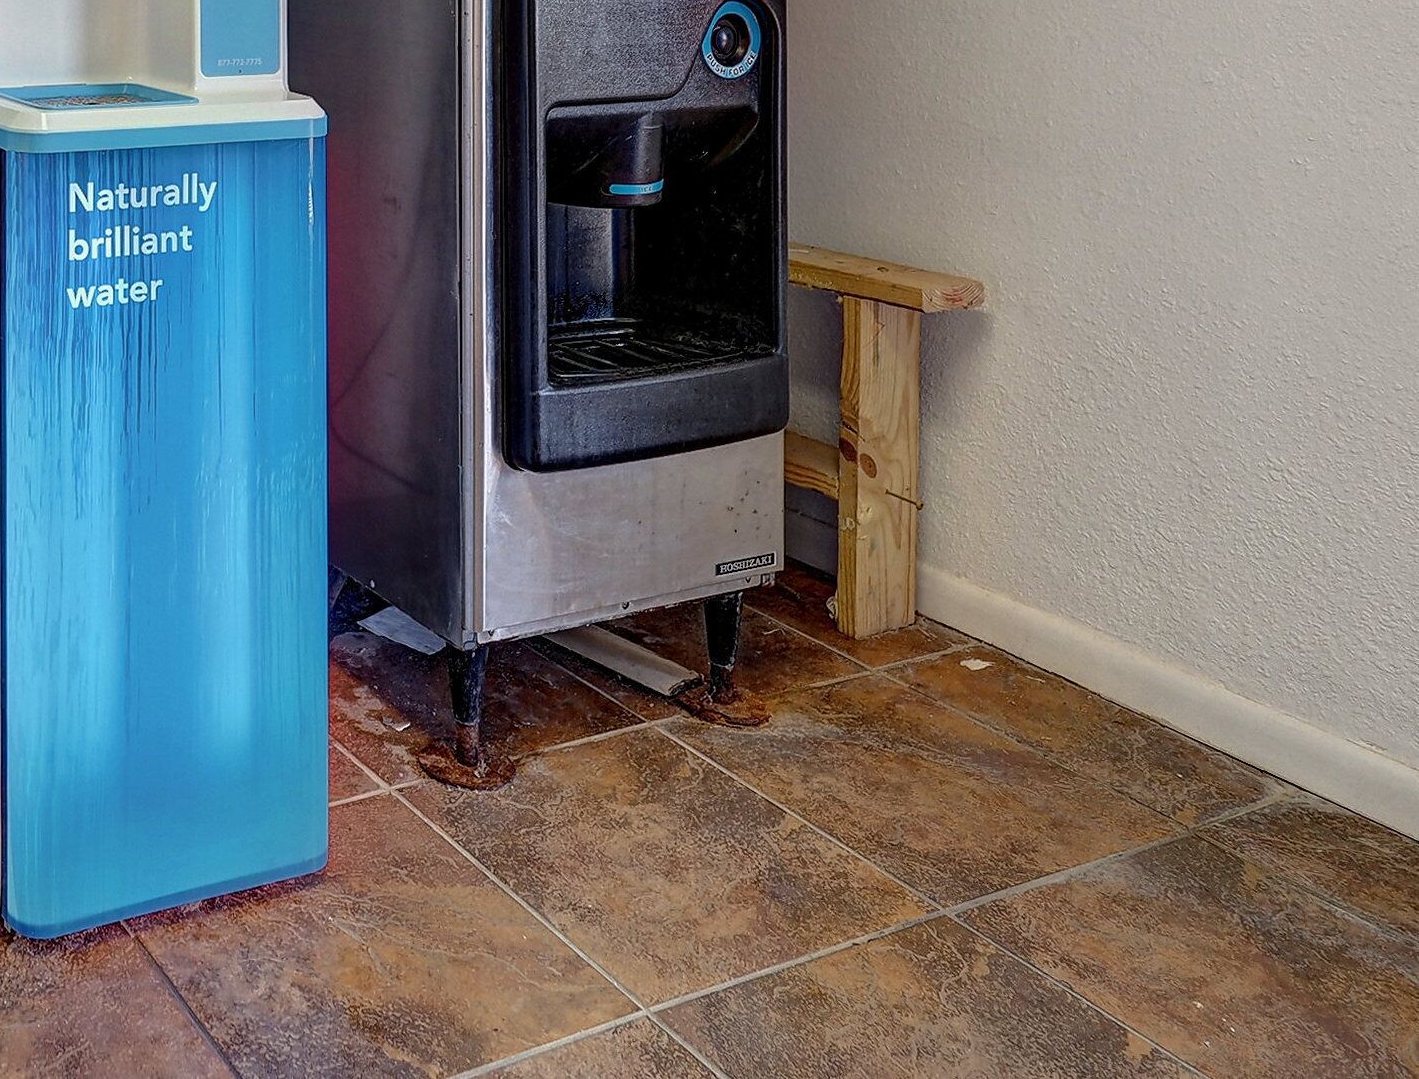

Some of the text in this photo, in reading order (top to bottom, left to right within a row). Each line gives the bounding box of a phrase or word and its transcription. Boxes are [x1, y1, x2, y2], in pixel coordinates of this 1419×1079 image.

[69, 173, 217, 213] Naturally
[68, 225, 193, 261] brilliant
[66, 278, 164, 309] water
[720, 555, 772, 573] HOSHIZAKI
